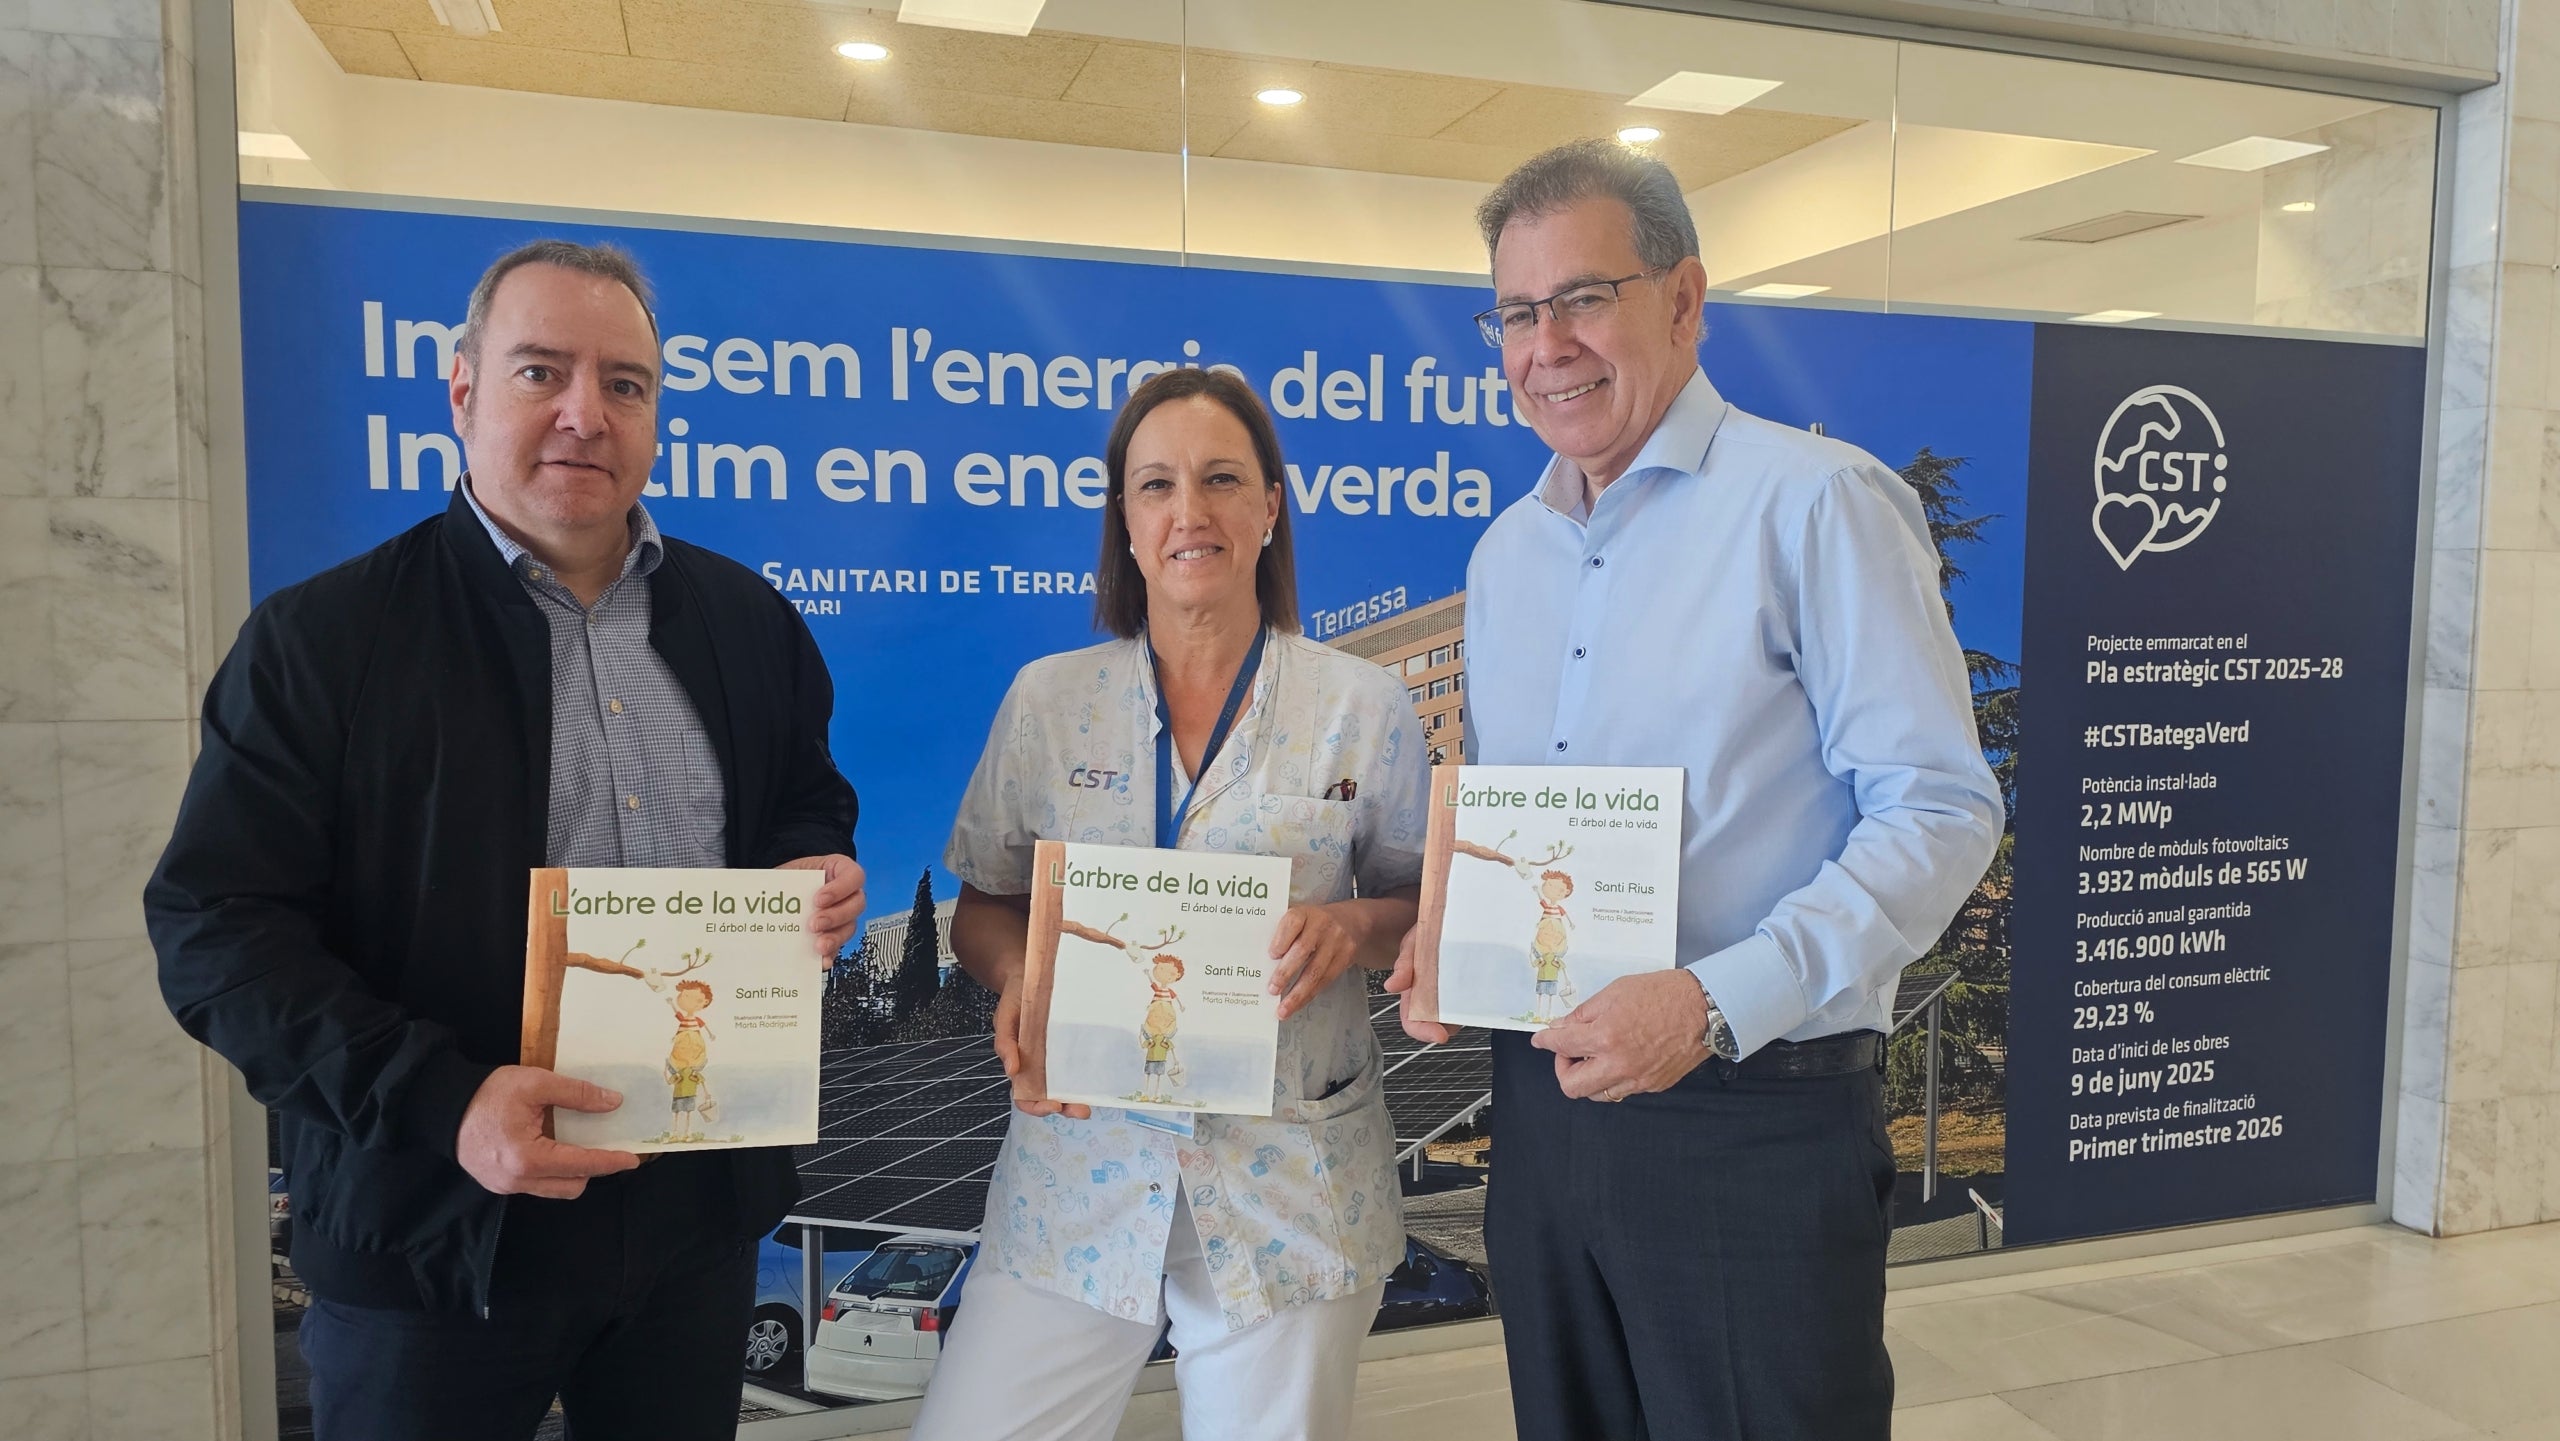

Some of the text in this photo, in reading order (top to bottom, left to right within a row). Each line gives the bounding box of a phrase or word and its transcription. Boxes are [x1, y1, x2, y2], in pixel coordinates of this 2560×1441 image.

[363, 301, 861, 398] Imsem
[1270, 350, 1384, 421] del
[1404, 355, 1532, 427] fut
[368, 415, 787, 500] Inim
[816, 448, 927, 504] en
[1286, 451, 1491, 517] verda
[762, 562, 1097, 594] SANITARI DE TERRA
[1312, 585, 1406, 638] Terrassa
[2088, 633, 2247, 654] Projecte emmarcat en el
[2087, 660, 2118, 683] Pla
[2124, 658, 2219, 687] estratègic
[2224, 658, 2261, 681] CST
[2084, 720, 2249, 750] #CSTBategaVerd
[1446, 783, 1659, 811] L'arbre de la vida
[2082, 776, 2142, 794] Potència
[1569, 817, 1657, 829] El árbol de la vida
[2081, 801, 2172, 830] 2,2 MWp
[2080, 834, 2289, 861] Nombre de mòduls fotovoltaics
[1052, 861, 1268, 899] L'arbre de la vida
[1594, 881, 1654, 894] Santi Rius
[2078, 858, 2308, 894] 3.932 mòduls de 565 W
[552, 888, 801, 916] L'arbre de la vida
[1181, 902, 1266, 916] El árbol de la vida
[2077, 901, 2251, 929] Producció anual garantida
[706, 922, 800, 933] El árbol de la vida
[2076, 929, 2225, 963] 3.416.900 kWh
[1205, 964, 1261, 978] Santi Rius
[2075, 965, 2271, 997] Cobertura del consum elèctric
[736, 987, 798, 999] Santi Rius
[2073, 1001, 2154, 1031] 29,23 %
[2072, 1048, 2104, 1064] Data
[2152, 1039, 2168, 1056] de
[2172, 1038, 2190, 1053] les
[2194, 1035, 2229, 1051] obres
[2072, 1060, 2214, 1096] 9 de juny 2025
[2070, 1094, 2255, 1130] Data prevista de finalització
[2069, 1115, 2282, 1162] Primer trimestre 2026
